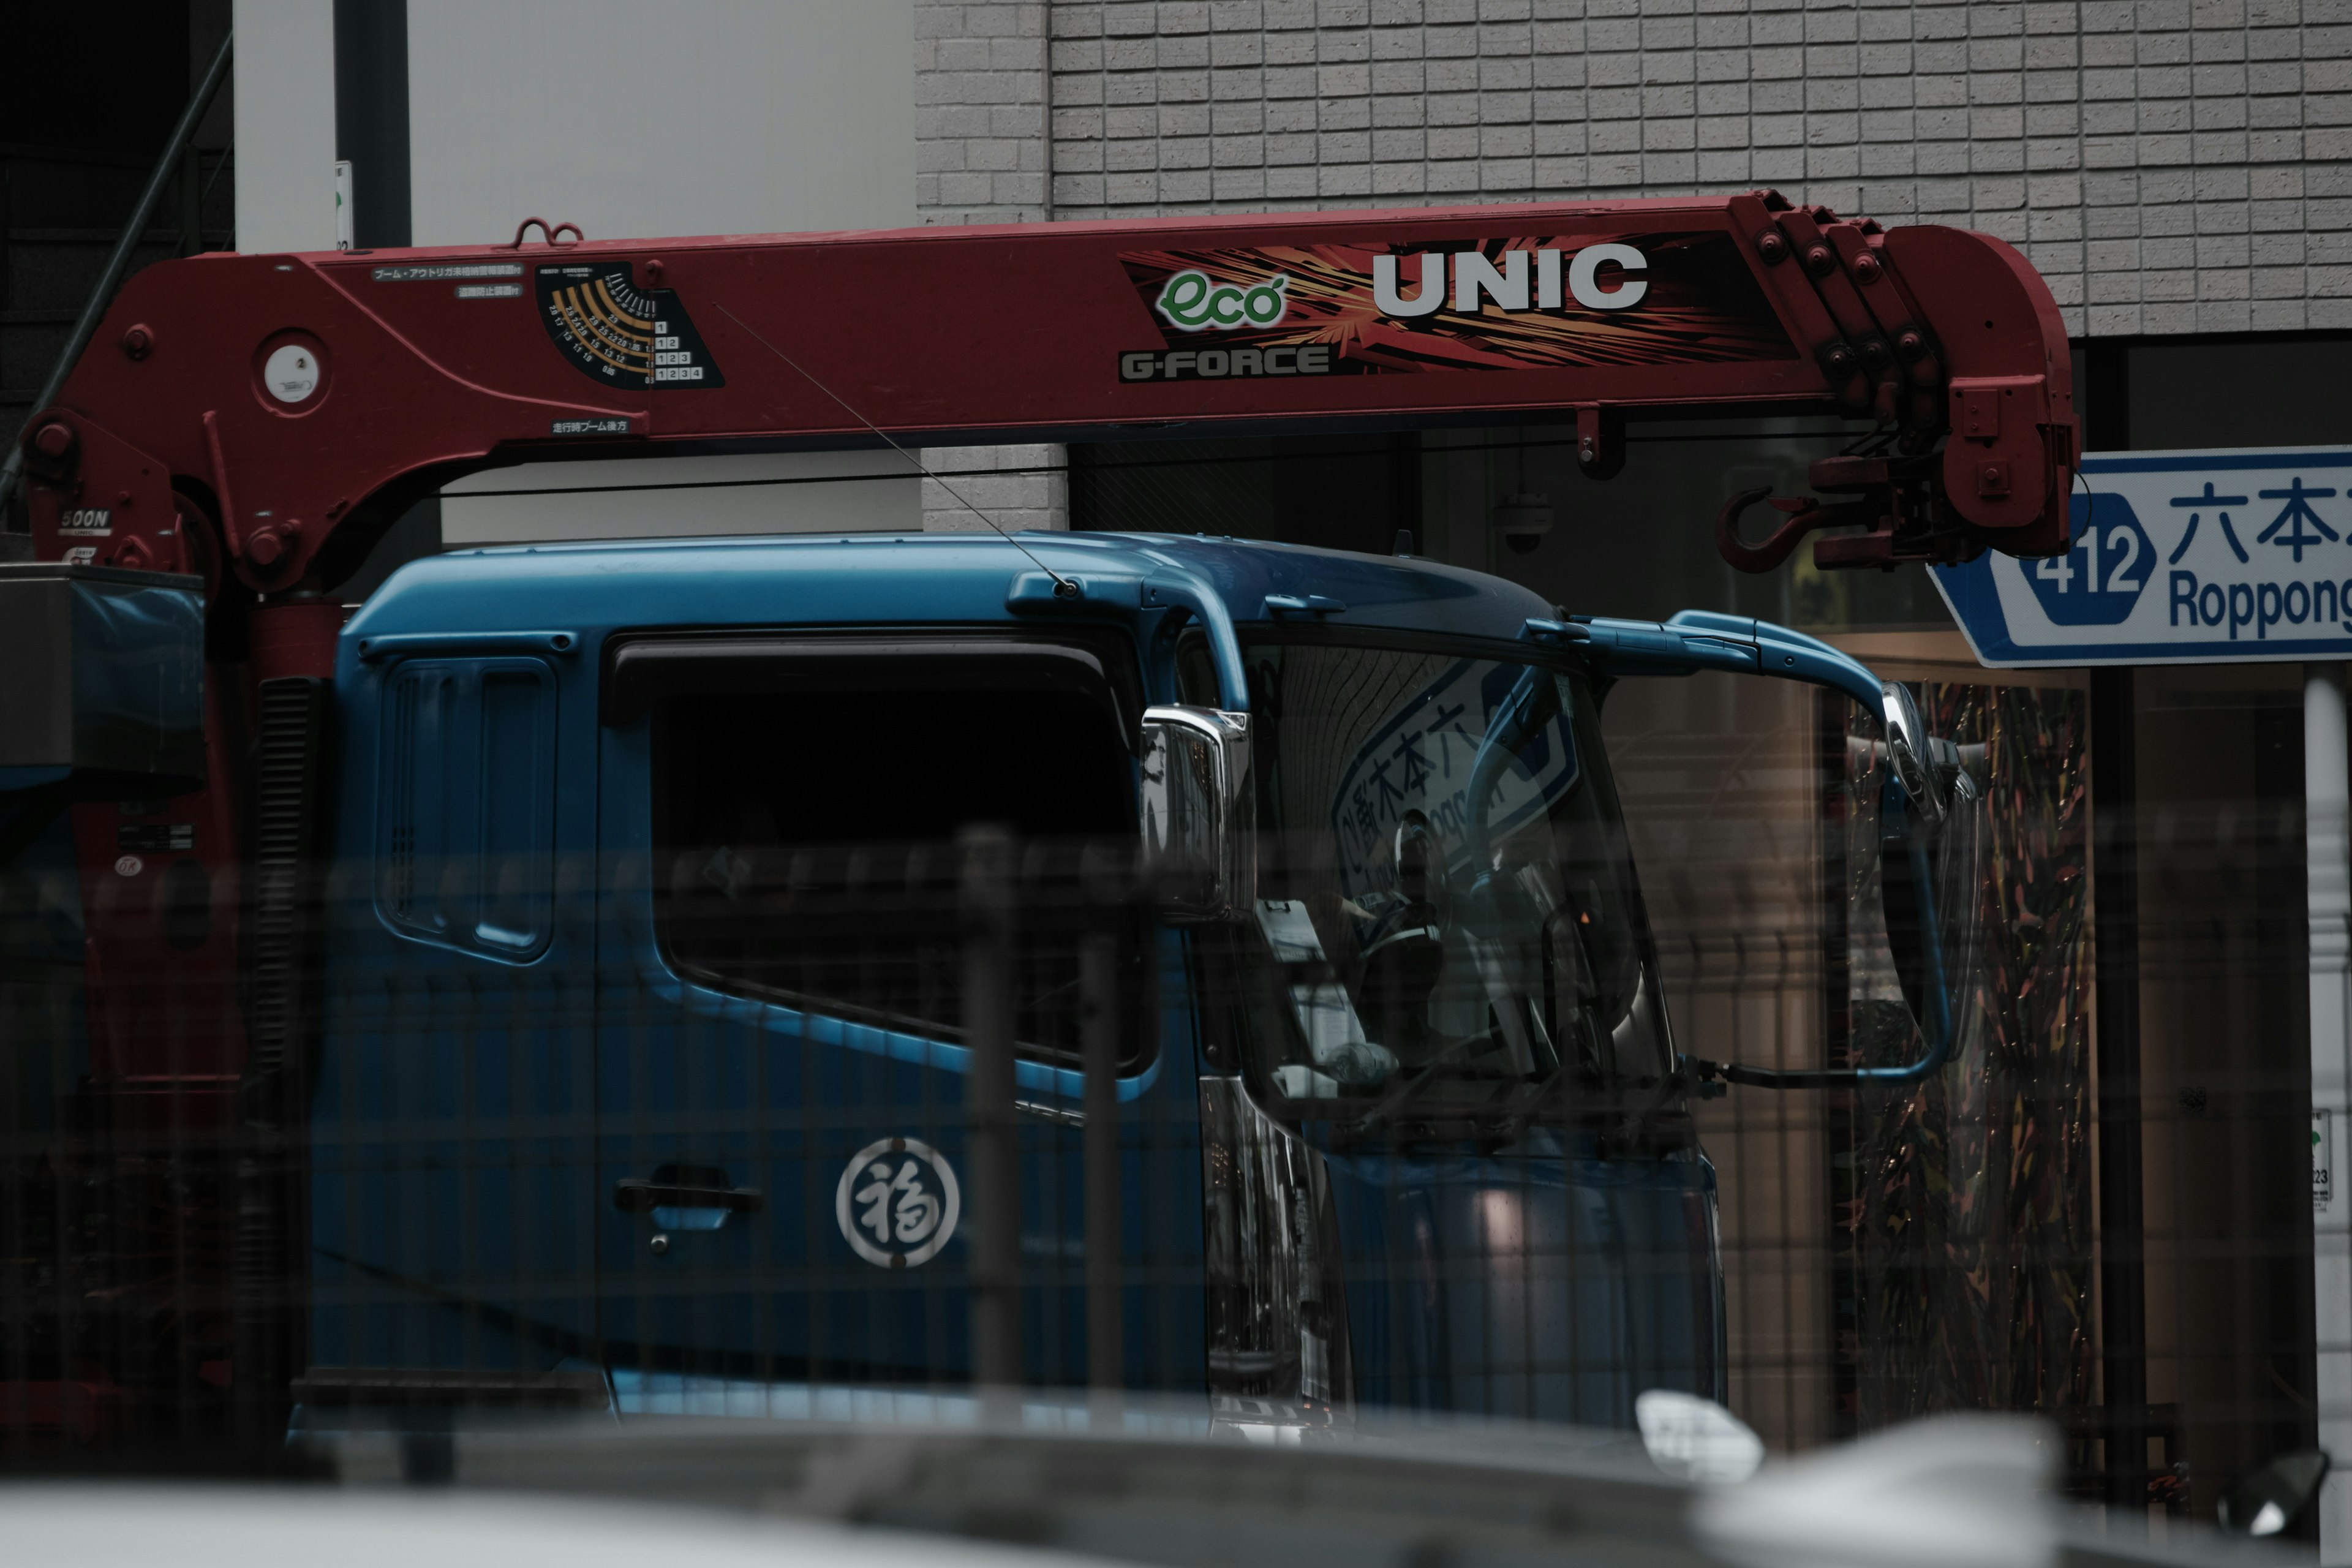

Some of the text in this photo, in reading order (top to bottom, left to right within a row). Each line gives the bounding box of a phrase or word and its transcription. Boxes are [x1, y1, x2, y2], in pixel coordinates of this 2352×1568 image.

[1159, 274, 1284, 326] eco
[1373, 243, 1648, 317] UNIC
[1121, 346, 1329, 380] G-FORCE
[552, 420, 627, 433] 走行時ブーム後方
[62, 510, 109, 527] 500N
[2168, 477, 2352, 565] 六本
[2312, 1169, 2328, 1184] 23
[855, 1160, 939, 1243] 福
